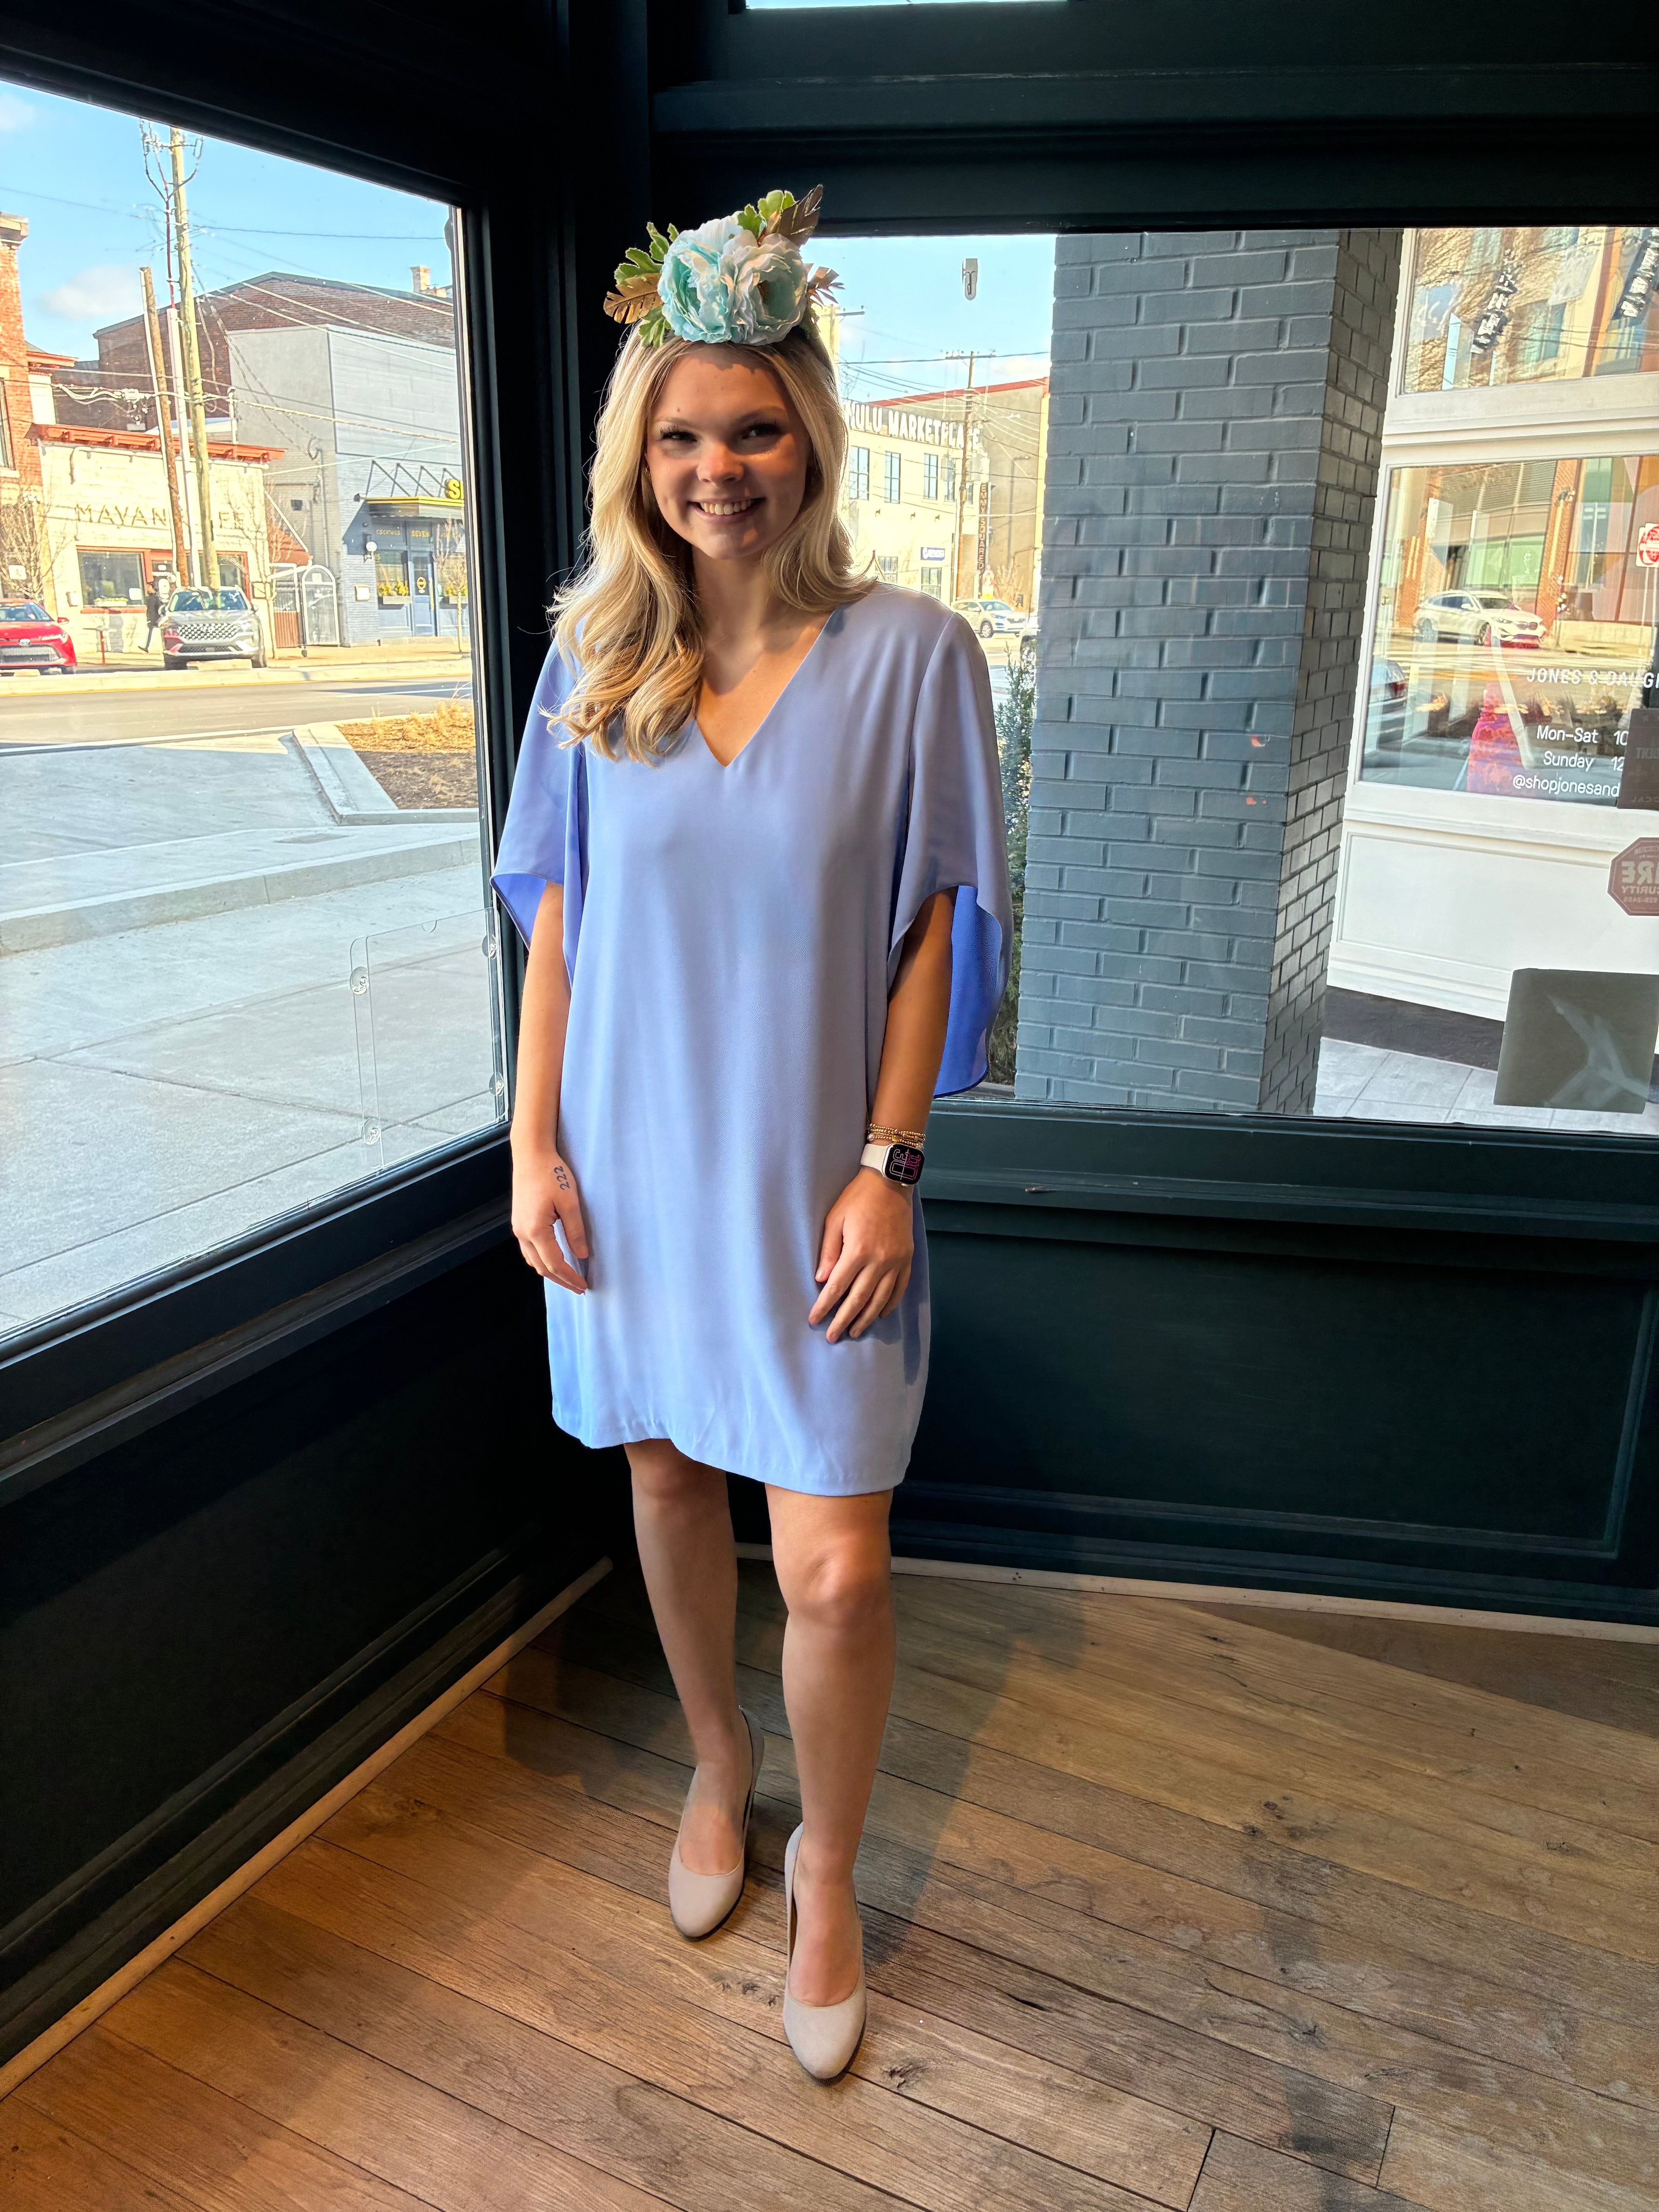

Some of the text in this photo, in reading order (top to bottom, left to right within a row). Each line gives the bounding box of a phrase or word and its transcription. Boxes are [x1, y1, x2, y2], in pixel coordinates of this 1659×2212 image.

[845, 402, 883, 433] NULU
[76, 504, 167, 526] MAYAN
[1527, 667, 1659, 689] JONES & DAUG
[1537, 725, 1598, 744] Mon-Sat
[1543, 750, 1625, 772] Sunday 12
[1512, 774, 1621, 797] @shopjonesand
[553, 1166, 570, 1190] 222
